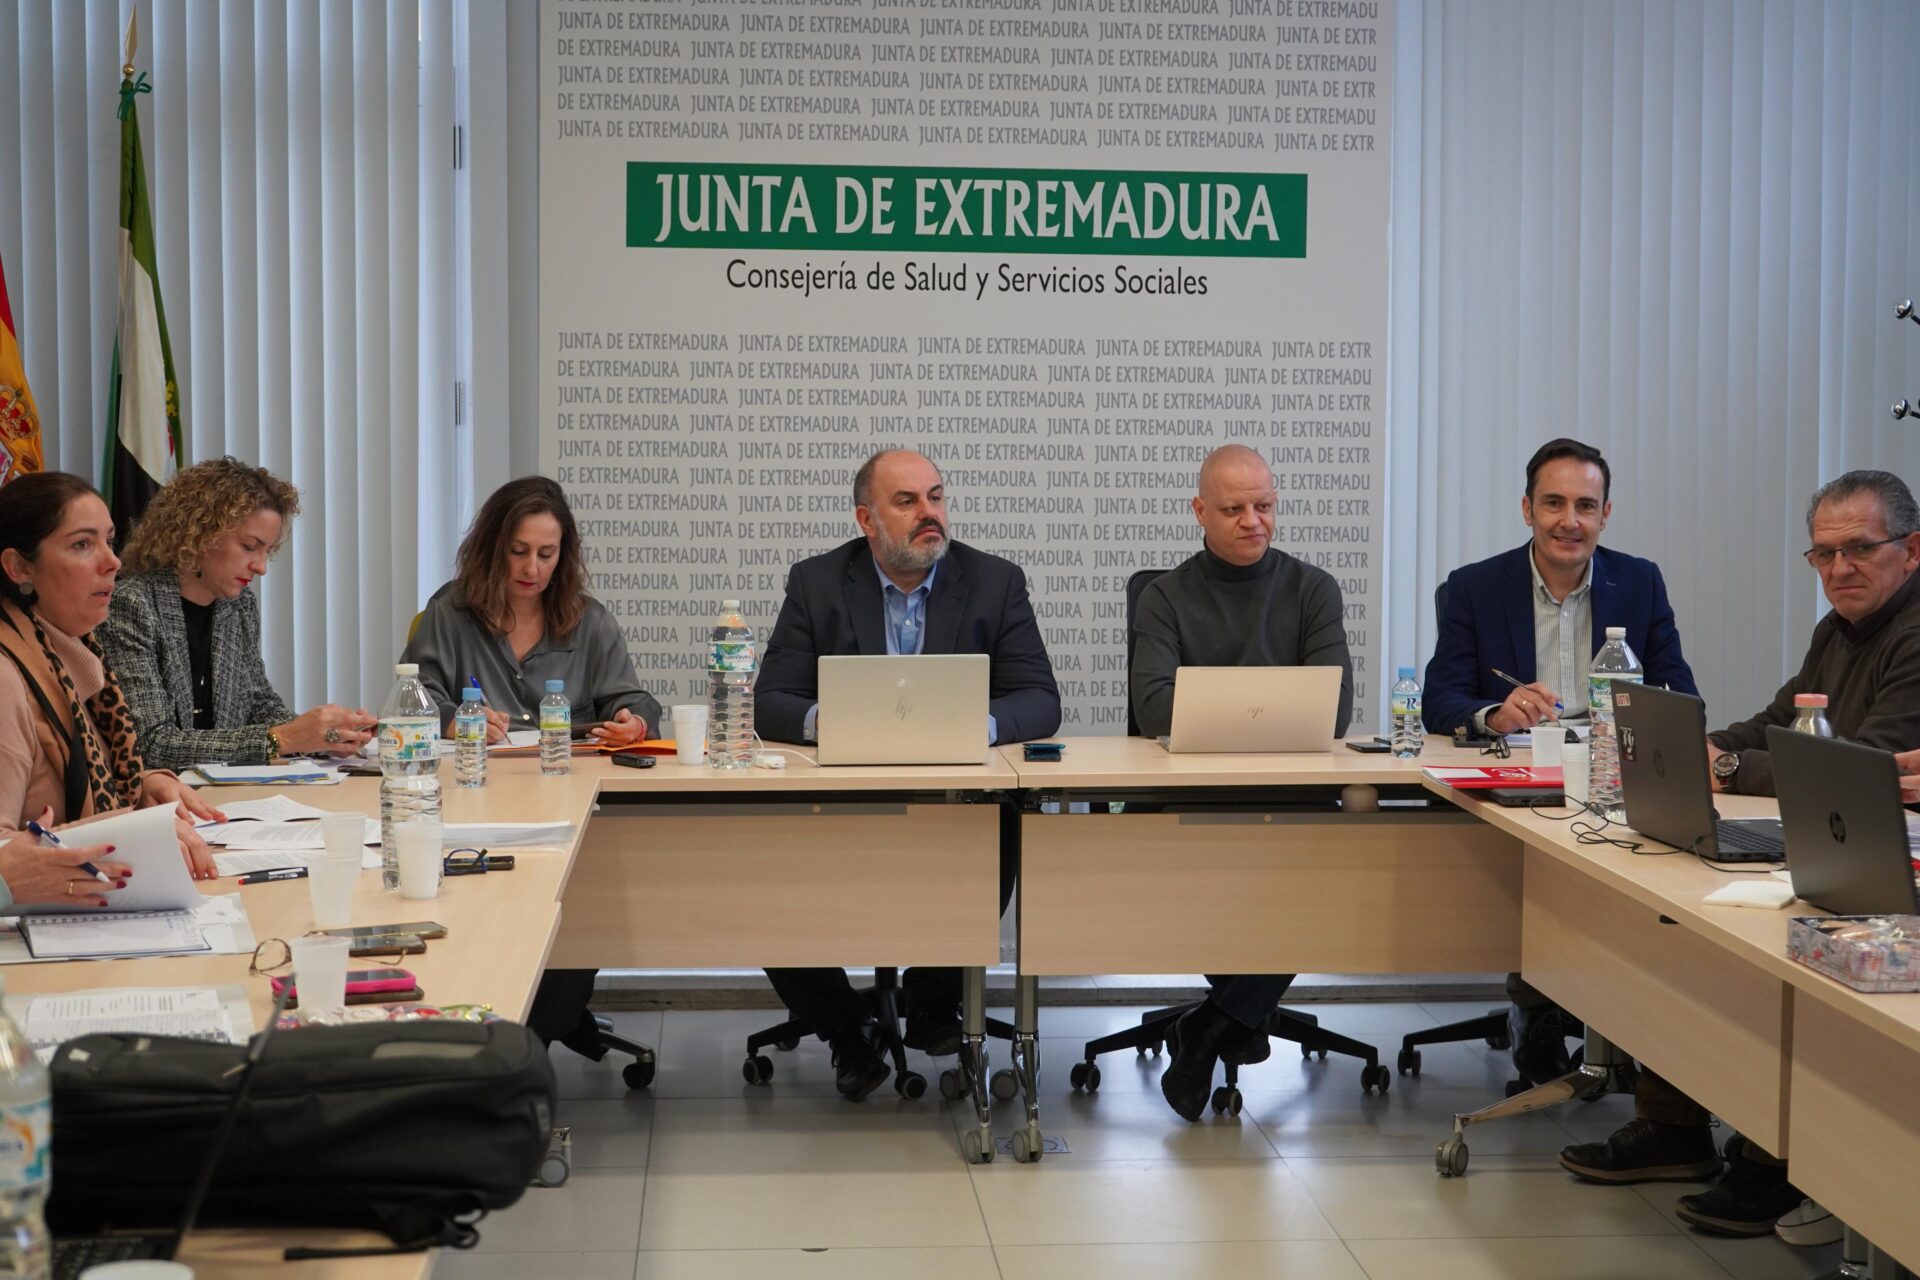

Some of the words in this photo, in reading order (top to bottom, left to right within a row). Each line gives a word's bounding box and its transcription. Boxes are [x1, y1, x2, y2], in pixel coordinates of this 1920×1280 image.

[1229, 0, 1272, 18] JUNTA
[1277, 0, 1293, 17] DE
[1298, 0, 1378, 19] EXTREMADU
[558, 12, 602, 31] JUNTA
[607, 12, 624, 29] DE
[629, 13, 730, 31] EXTREMADURA
[740, 14, 784, 34] JUNTA
[789, 15, 805, 32] DE
[810, 16, 910, 35] EXTREMADURA
[920, 18, 963, 38] JUNTA
[968, 19, 984, 36] DE
[990, 19, 1089, 39] EXTREMADURA
[1099, 22, 1142, 42] JUNTA
[1147, 23, 1163, 40] DE
[1168, 24, 1267, 42] EXTREMADURA
[1276, 26, 1319, 46] JUNTA
[1324, 27, 1340, 44] DE
[1345, 28, 1376, 45] EXTR
[558, 39, 574, 56] DE
[580, 39, 681, 57] EXTREMADURA
[691, 41, 735, 61] JUNTA
[740, 41, 756, 58] DE
[761, 42, 861, 60] EXTREMADURA
[872, 44, 915, 64] JUNTA
[919, 45, 936, 62] DE
[941, 46, 1041, 64] EXTREMADURA
[1051, 48, 1094, 68] JUNTA
[1098, 49, 1114, 66] DE
[1119, 49, 1218, 68] EXTREMADURA
[1229, 52, 1271, 72] JUNTA
[1276, 53, 1292, 70] DE
[1297, 54, 1376, 72] EXTREMADU
[558, 66, 602, 85] JUNTA
[607, 66, 623, 83] DE
[629, 67, 730, 85] EXTREMADURA
[740, 68, 783, 88] JUNTA
[788, 69, 804, 86] DE
[810, 69, 910, 88] EXTREMADURA
[920, 72, 963, 92] JUNTA
[968, 73, 984, 90] DE
[989, 73, 1088, 92] EXTREMADURA
[1098, 75, 1141, 95] JUNTA
[1146, 76, 1162, 93] DE
[1167, 77, 1266, 95] EXTREMADURA
[1276, 80, 1318, 99] JUNTA
[1323, 80, 1339, 97] DE
[1344, 81, 1375, 98] EXTR
[558, 93, 574, 110] DE
[579, 93, 680, 111] EXTREMADURA
[691, 95, 735, 115] JUNTA
[739, 95, 755, 112] DE
[760, 96, 861, 114] EXTREMADURA
[871, 98, 915, 118] JUNTA
[919, 99, 935, 116] DE
[940, 99, 1040, 118] EXTREMADURA
[1050, 101, 1093, 121] JUNTA
[1097, 102, 1113, 119] DE
[1119, 103, 1217, 121] EXTREMADURA
[1228, 105, 1270, 125] JUNTA
[1275, 107, 1291, 123] DE
[1296, 107, 1375, 125] EXTREMADU
[558, 120, 602, 140] JUNTA
[607, 120, 623, 137] DE
[628, 121, 729, 139] EXTREMADURA
[739, 122, 782, 141] JUNTA
[787, 123, 804, 140] DE
[809, 123, 909, 142] EXTREMADURA
[919, 126, 962, 146] JUNTA
[967, 127, 983, 143] DE
[988, 127, 1088, 146] EXTREMADURA
[1097, 129, 1141, 149] JUNTA
[1145, 130, 1161, 147] DE
[1166, 130, 1264, 149] EXTREMADURA
[1275, 133, 1317, 152] JUNTA
[1322, 134, 1338, 151] DE
[1343, 134, 1374, 151] EXTR
[655, 174, 817, 242] JUNTA
[836, 177, 894, 234] DE
[915, 179, 1279, 240] EXTREMADURA
[726, 259, 858, 298] Consejería
[866, 261, 895, 291] de
[904, 261, 967, 292] Salud
[975, 272, 990, 301] y
[997, 262, 1105, 294] Servicios
[1114, 264, 1208, 296] Sociales
[558, 332, 602, 352] JUNTA
[607, 333, 623, 349] DE
[628, 333, 728, 351] EXTREMADURA
[739, 334, 782, 354] JUNTA
[787, 335, 803, 352] DE
[808, 335, 908, 353] EXTREMADURA
[918, 337, 961, 357] JUNTA
[966, 337, 982, 354] DE
[987, 338, 1086, 355] EXTREMADURA
[1096, 339, 1139, 359] JUNTA
[1143, 340, 1159, 356] DE
[1164, 340, 1262, 357] EXTREMADURA
[1272, 341, 1315, 361] JUNTA
[1319, 342, 1335, 358] DE
[1340, 342, 1371, 359] EXTR
[558, 360, 574, 377] DE
[579, 360, 680, 378] EXTREMADURA
[690, 361, 734, 381] JUNTA
[738, 362, 755, 379] DE
[760, 362, 859, 380] EXTREMADURA
[870, 363, 913, 383] JUNTA
[917, 363, 933, 380] DE
[939, 364, 1038, 381] EXTREMADURA
[1048, 365, 1091, 385] JUNTA
[1095, 366, 1111, 382] DE
[1116, 366, 1215, 383] EXTREMADURA
[1224, 368, 1267, 387] JUNTA
[1271, 368, 1287, 385] DE
[1292, 368, 1371, 385] EXTREMADU
[558, 440, 602, 460] JUNTA
[607, 440, 623, 457] DE
[628, 440, 728, 458] EXTREMADURA
[738, 442, 782, 462] JUNTA
[787, 442, 803, 459] DE
[1271, 447, 1313, 466] JUNTA
[1318, 447, 1334, 463] DE
[1339, 447, 1370, 464] EXTR
[558, 466, 574, 483] DE
[579, 467, 679, 484] EXTREMADURA
[690, 468, 733, 487] JUNTA
[738, 469, 755, 485] DE
[606, 493, 623, 510] DE
[628, 493, 728, 511] EXTREMADURA
[738, 495, 782, 515] JUNTA
[787, 495, 803, 512] DE
[964, 496, 980, 513] DE
[985, 496, 1084, 514] EXTREMADURA
[1094, 497, 1137, 517] JUNTA
[1141, 498, 1158, 515] DE
[689, 521, 733, 540] JUNTA
[738, 522, 755, 539] DE
[760, 522, 859, 539] EXTREMADURA
[606, 547, 622, 563] DE
[628, 547, 728, 564] EXTREMADURA
[739, 548, 782, 568] JUNTA
[689, 573, 733, 593] JUNTA
[737, 574, 753, 590] DE
[1045, 576, 1088, 595] JUNTA
[1092, 576, 1108, 592] DE
